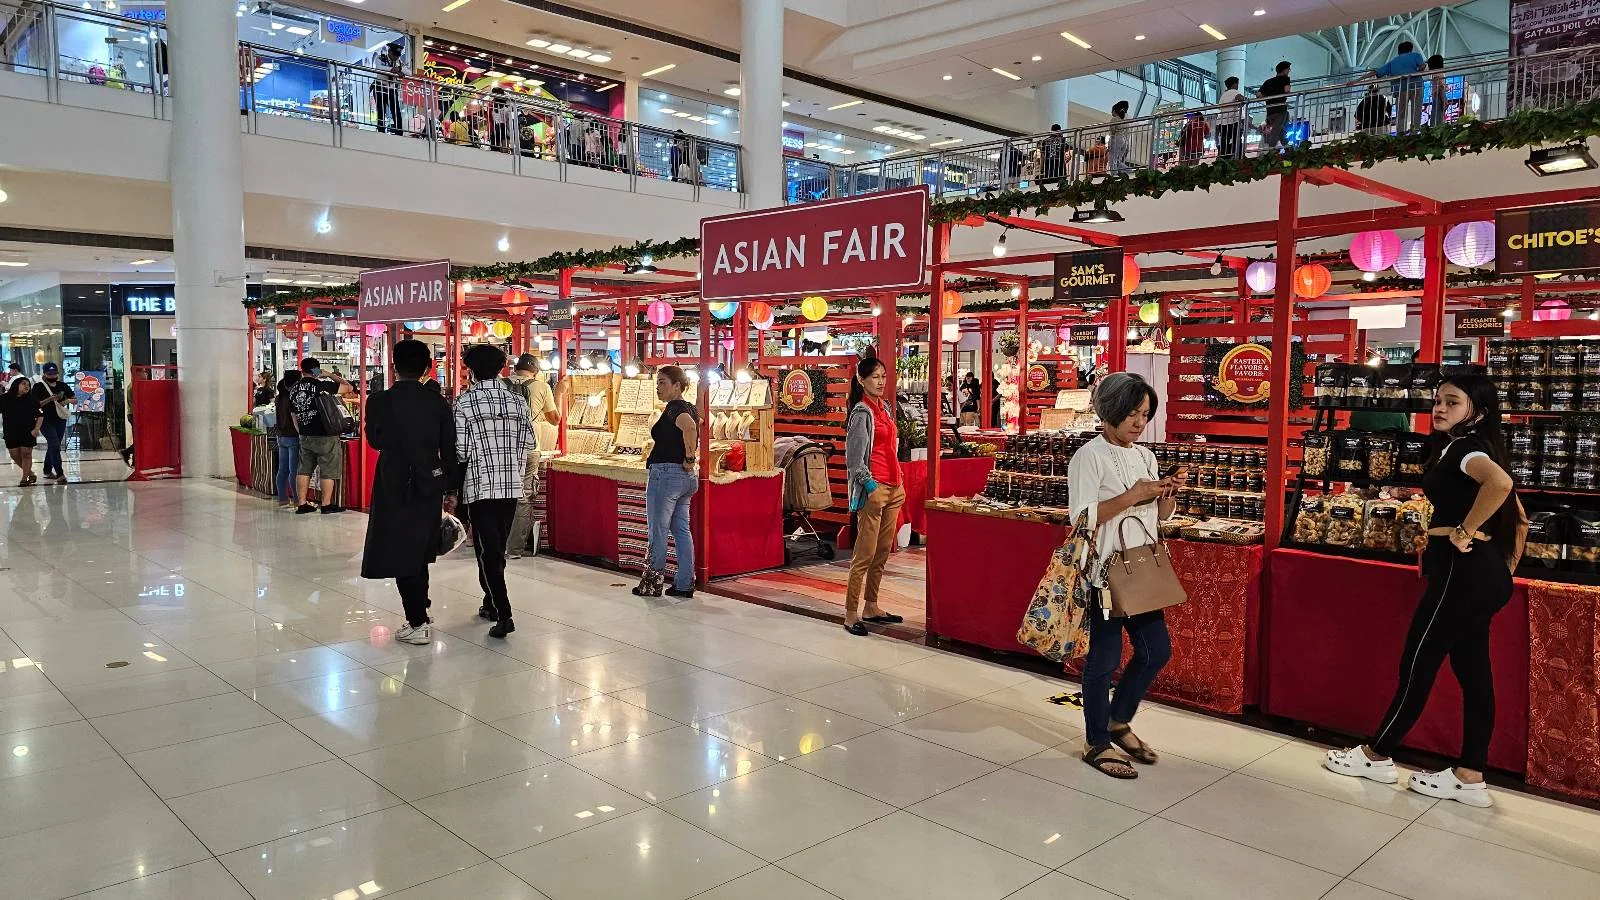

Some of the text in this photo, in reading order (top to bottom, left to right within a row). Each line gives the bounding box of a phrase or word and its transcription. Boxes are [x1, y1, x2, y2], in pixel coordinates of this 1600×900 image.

[1545, 25, 1561, 35] ALL
[1562, 20, 1581, 33] YOU
[1507, 228, 1600, 250] CHITOE'S
[712, 222, 907, 276] ASIAN FAIR
[1071, 263, 1105, 277] SAM'S
[1060, 273, 1116, 288] GOURMET
[363, 279, 443, 308] ASIAN FAIR
[127, 296, 162, 312] THE
